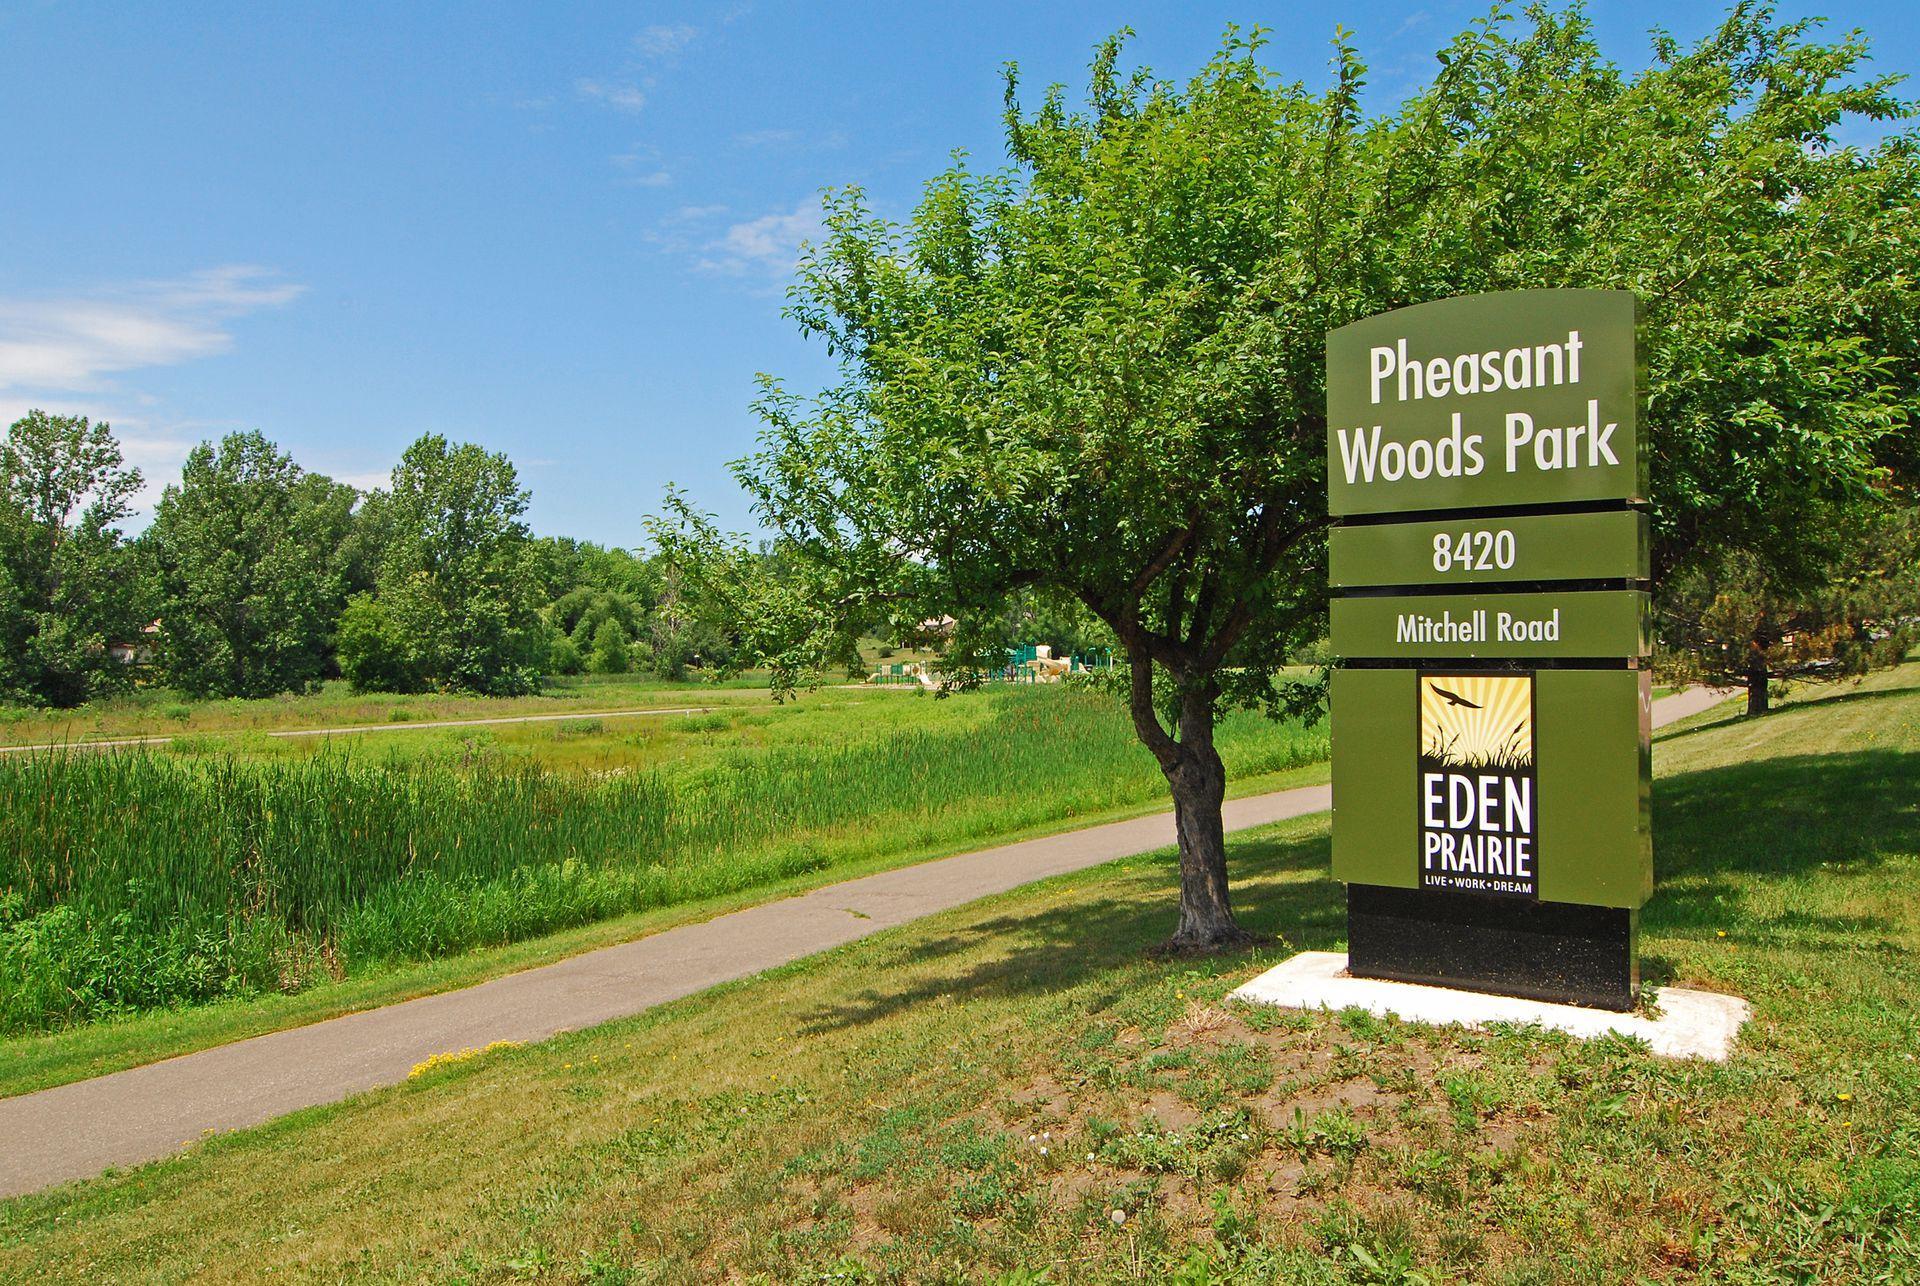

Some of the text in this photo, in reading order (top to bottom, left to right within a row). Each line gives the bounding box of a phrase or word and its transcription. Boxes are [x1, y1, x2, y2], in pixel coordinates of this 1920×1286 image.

[1370, 330, 1583, 404] Pheasant
[1337, 399, 1620, 484] Woods Park
[1432, 529, 1516, 572] 8420
[1396, 608, 1560, 643] Mitchell Road
[1424, 772, 1531, 834] EDEN
[1425, 832, 1531, 877] PRAIRIE
